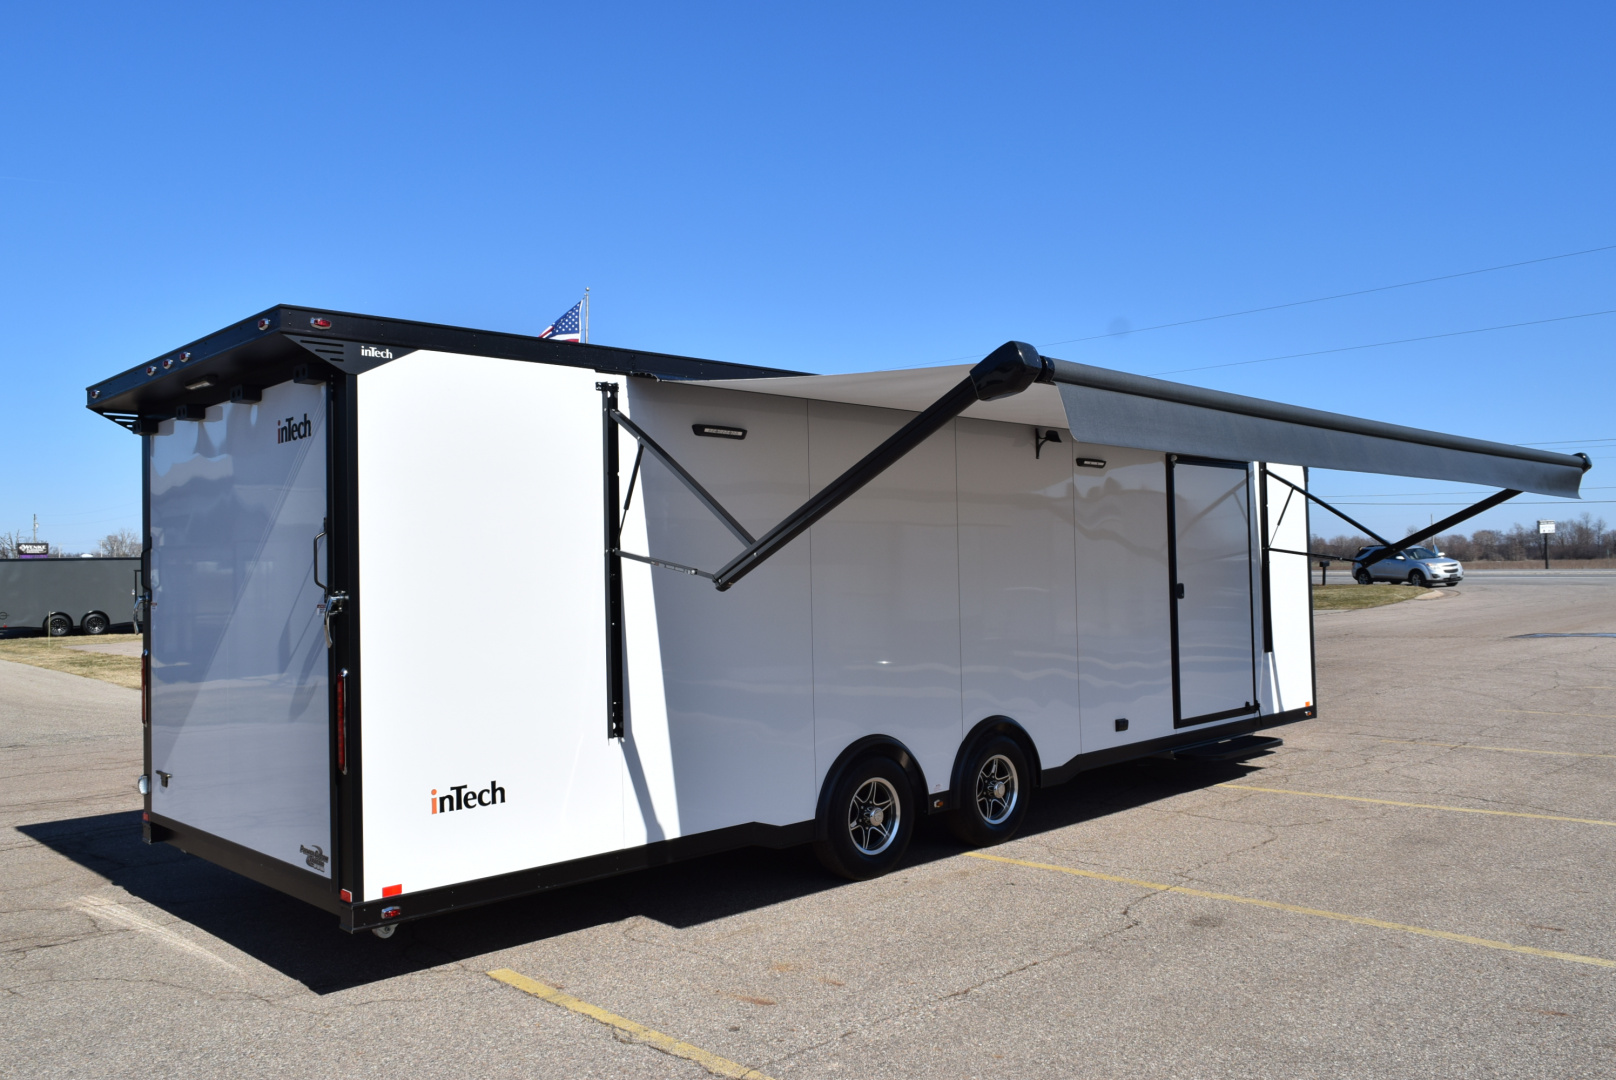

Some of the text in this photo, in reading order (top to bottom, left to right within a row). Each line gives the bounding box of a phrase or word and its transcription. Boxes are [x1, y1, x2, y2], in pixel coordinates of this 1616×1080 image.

[361, 345, 393, 359] inTech
[277, 413, 312, 444] inTech
[431, 780, 506, 815] inTech
